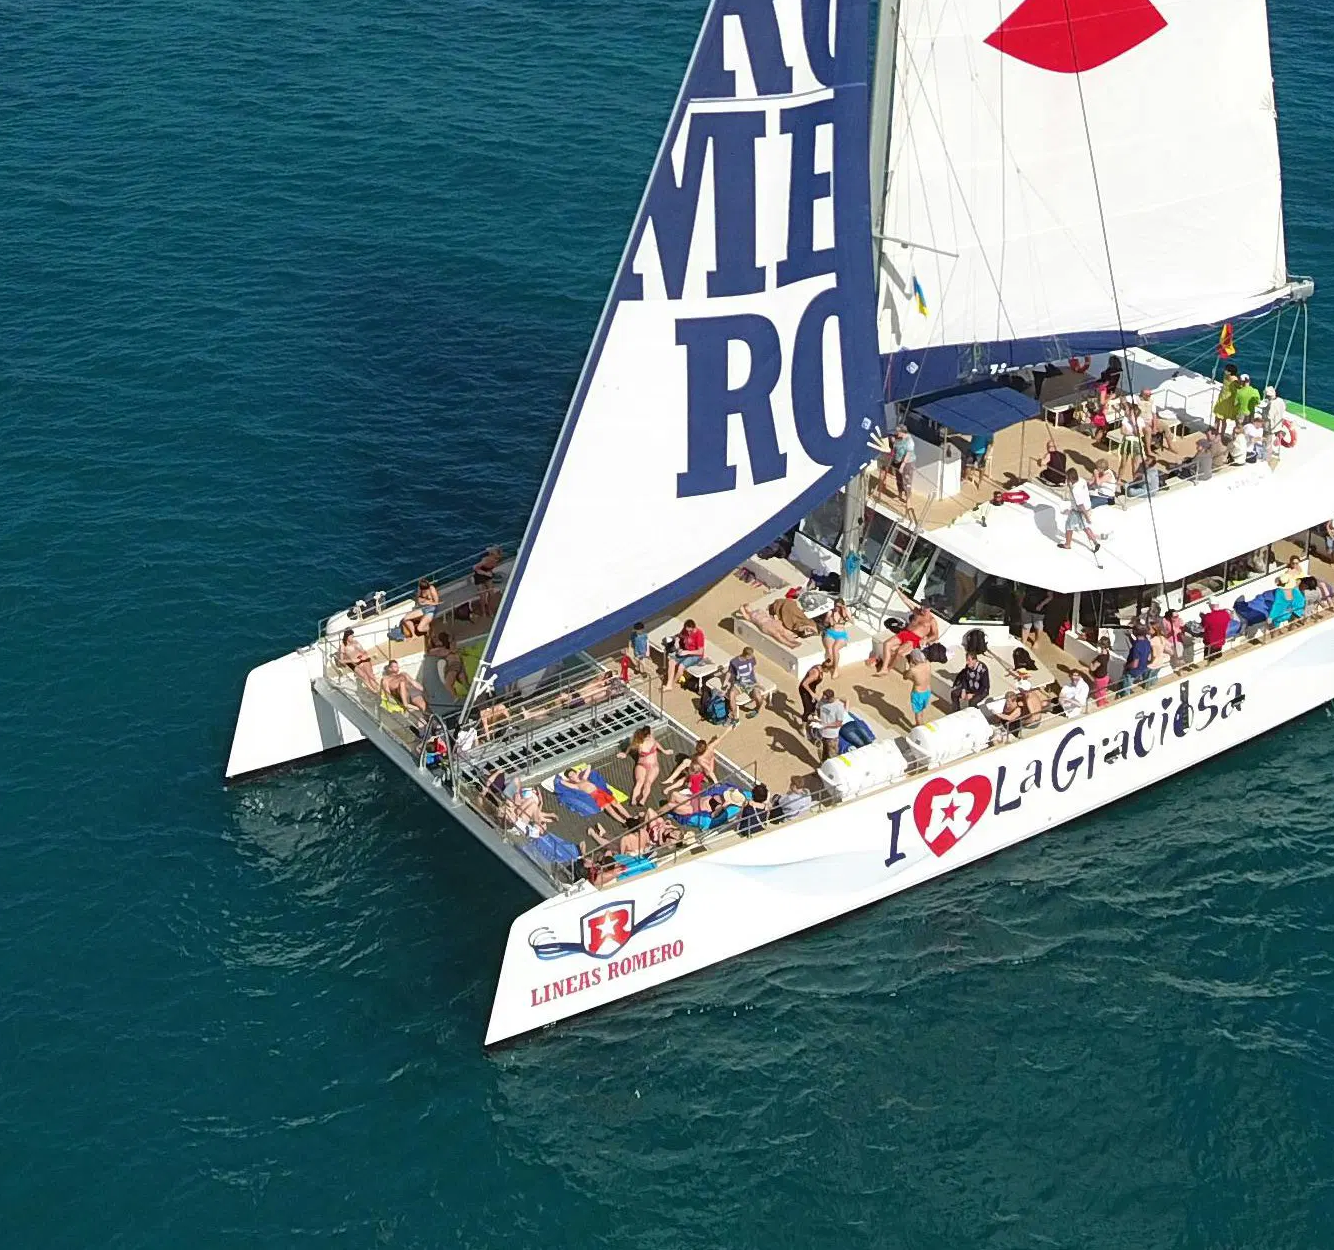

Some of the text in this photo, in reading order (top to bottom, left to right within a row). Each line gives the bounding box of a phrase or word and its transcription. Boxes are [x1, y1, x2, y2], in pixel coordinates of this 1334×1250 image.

[675, 287, 851, 498] RO
[885, 805, 912, 867] I
[531, 940, 684, 1008] LINEAS ROMERO
